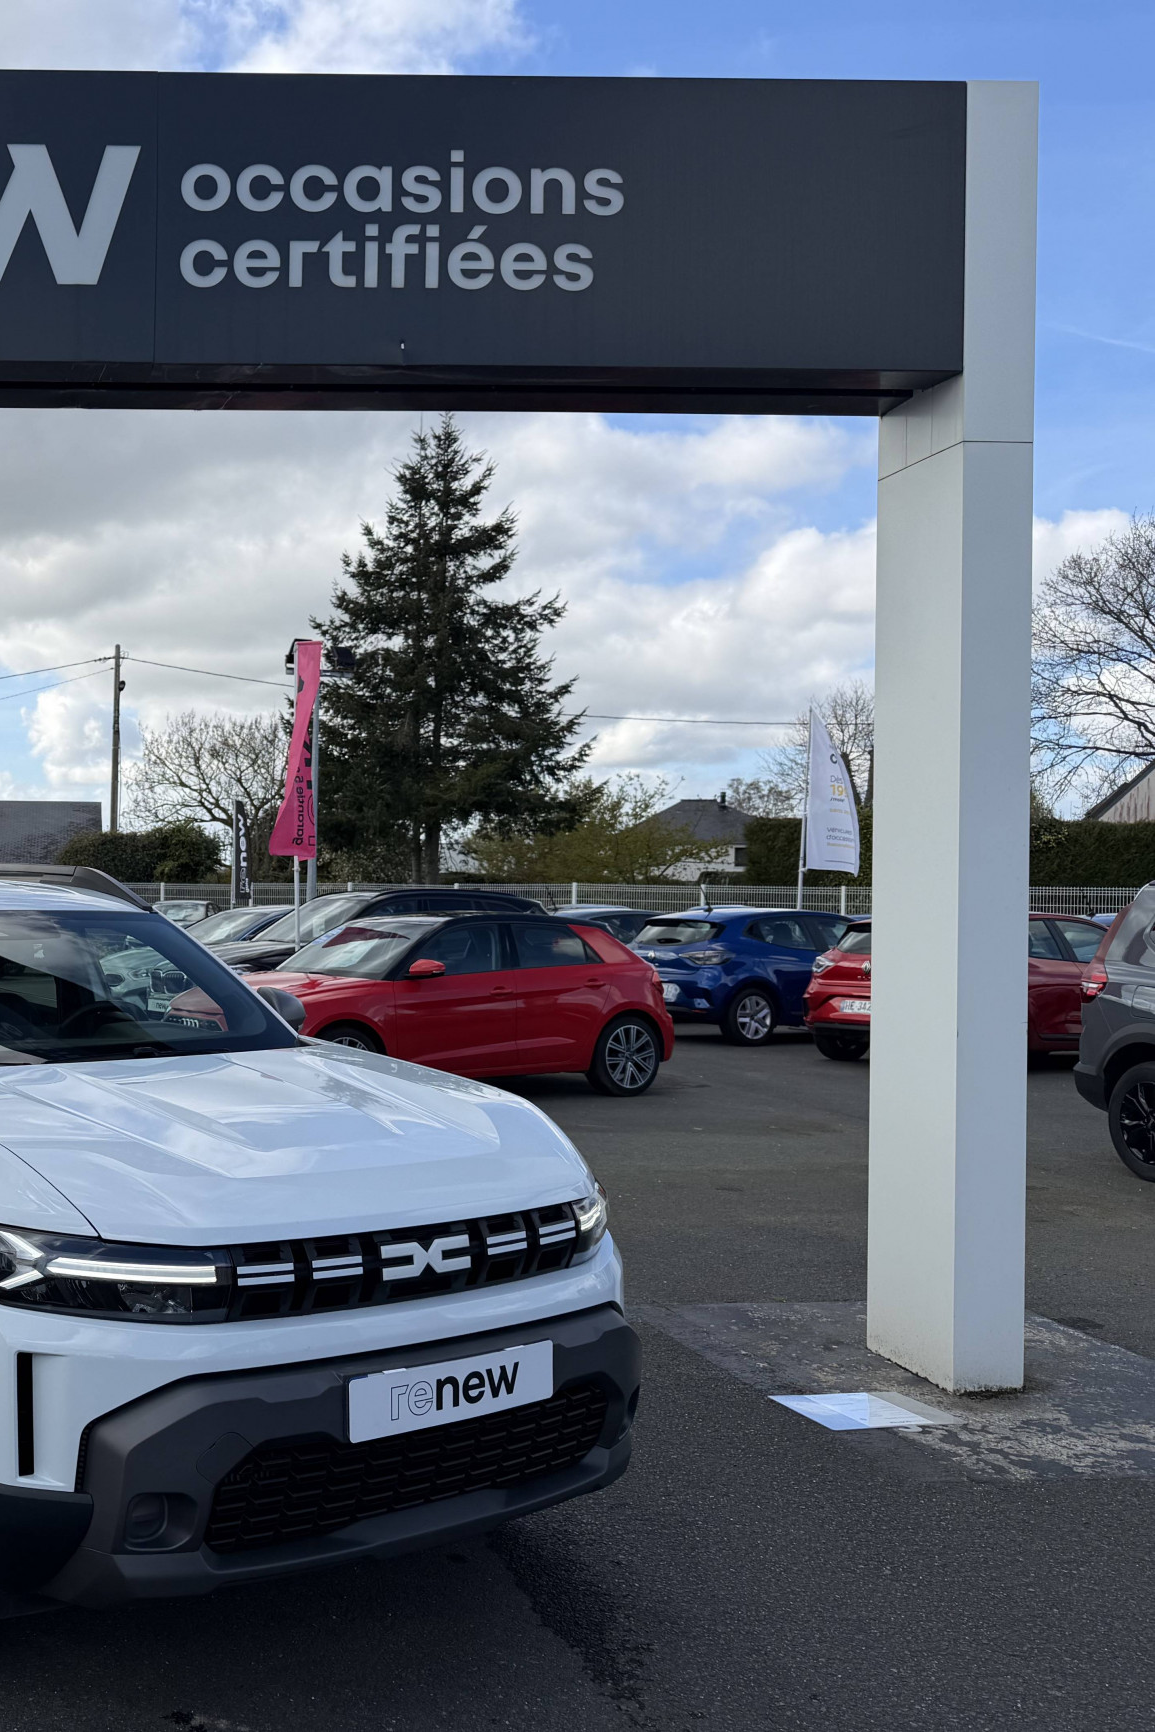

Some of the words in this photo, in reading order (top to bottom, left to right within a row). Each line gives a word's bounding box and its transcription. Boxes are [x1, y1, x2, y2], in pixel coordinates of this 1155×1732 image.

[180, 149, 624, 216] occasions
[179, 224, 594, 291] certifiées
[390, 1361, 520, 1421] renew
